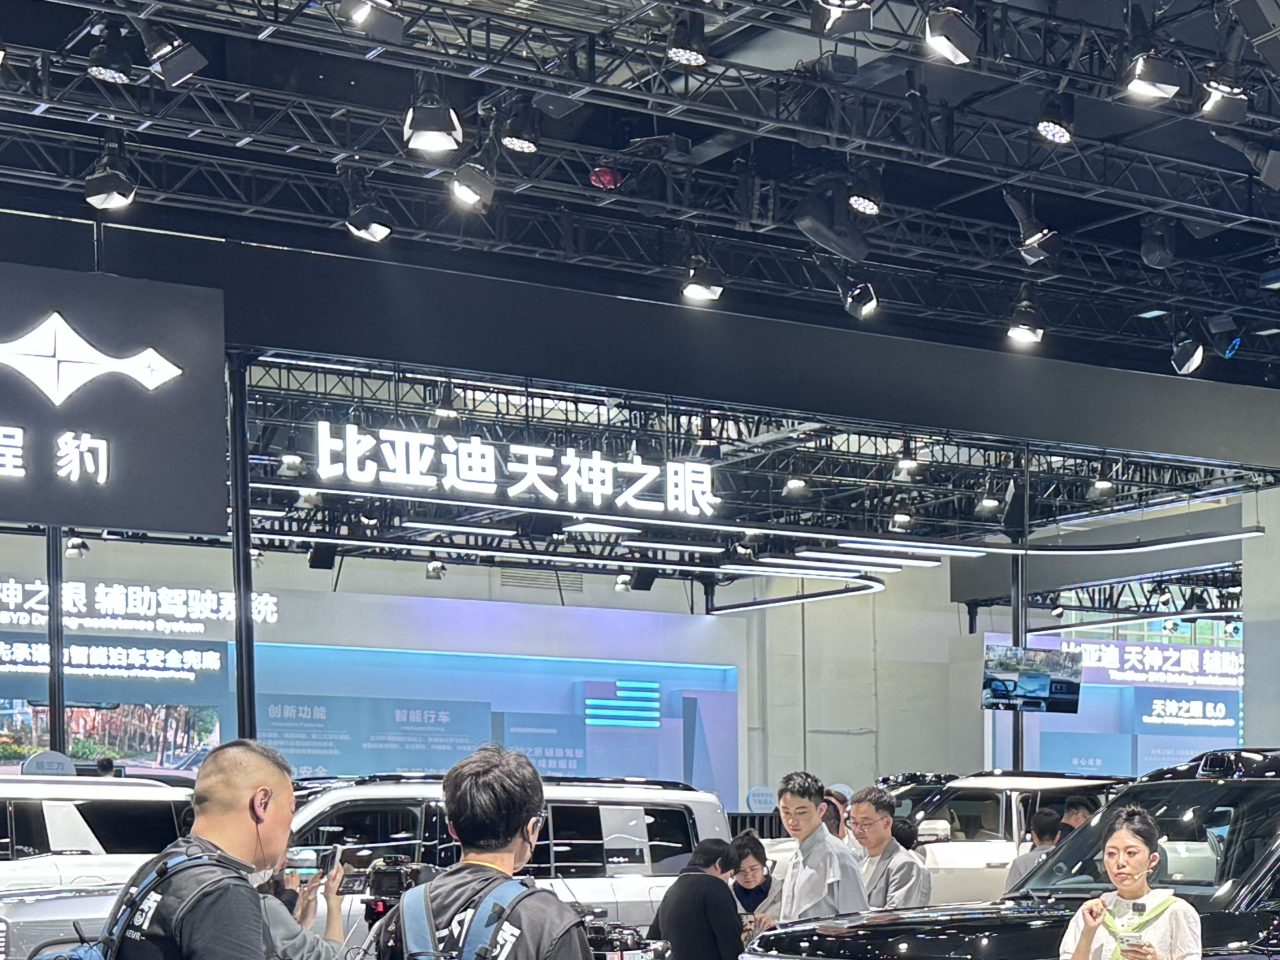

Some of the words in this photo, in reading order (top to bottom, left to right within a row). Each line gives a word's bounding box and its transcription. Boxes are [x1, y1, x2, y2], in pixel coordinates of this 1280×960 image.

[316, 420, 722, 517] 比亚迪天神之眼
[268, 704, 327, 720] 创新功能
[394, 708, 450, 724] 智能行车
